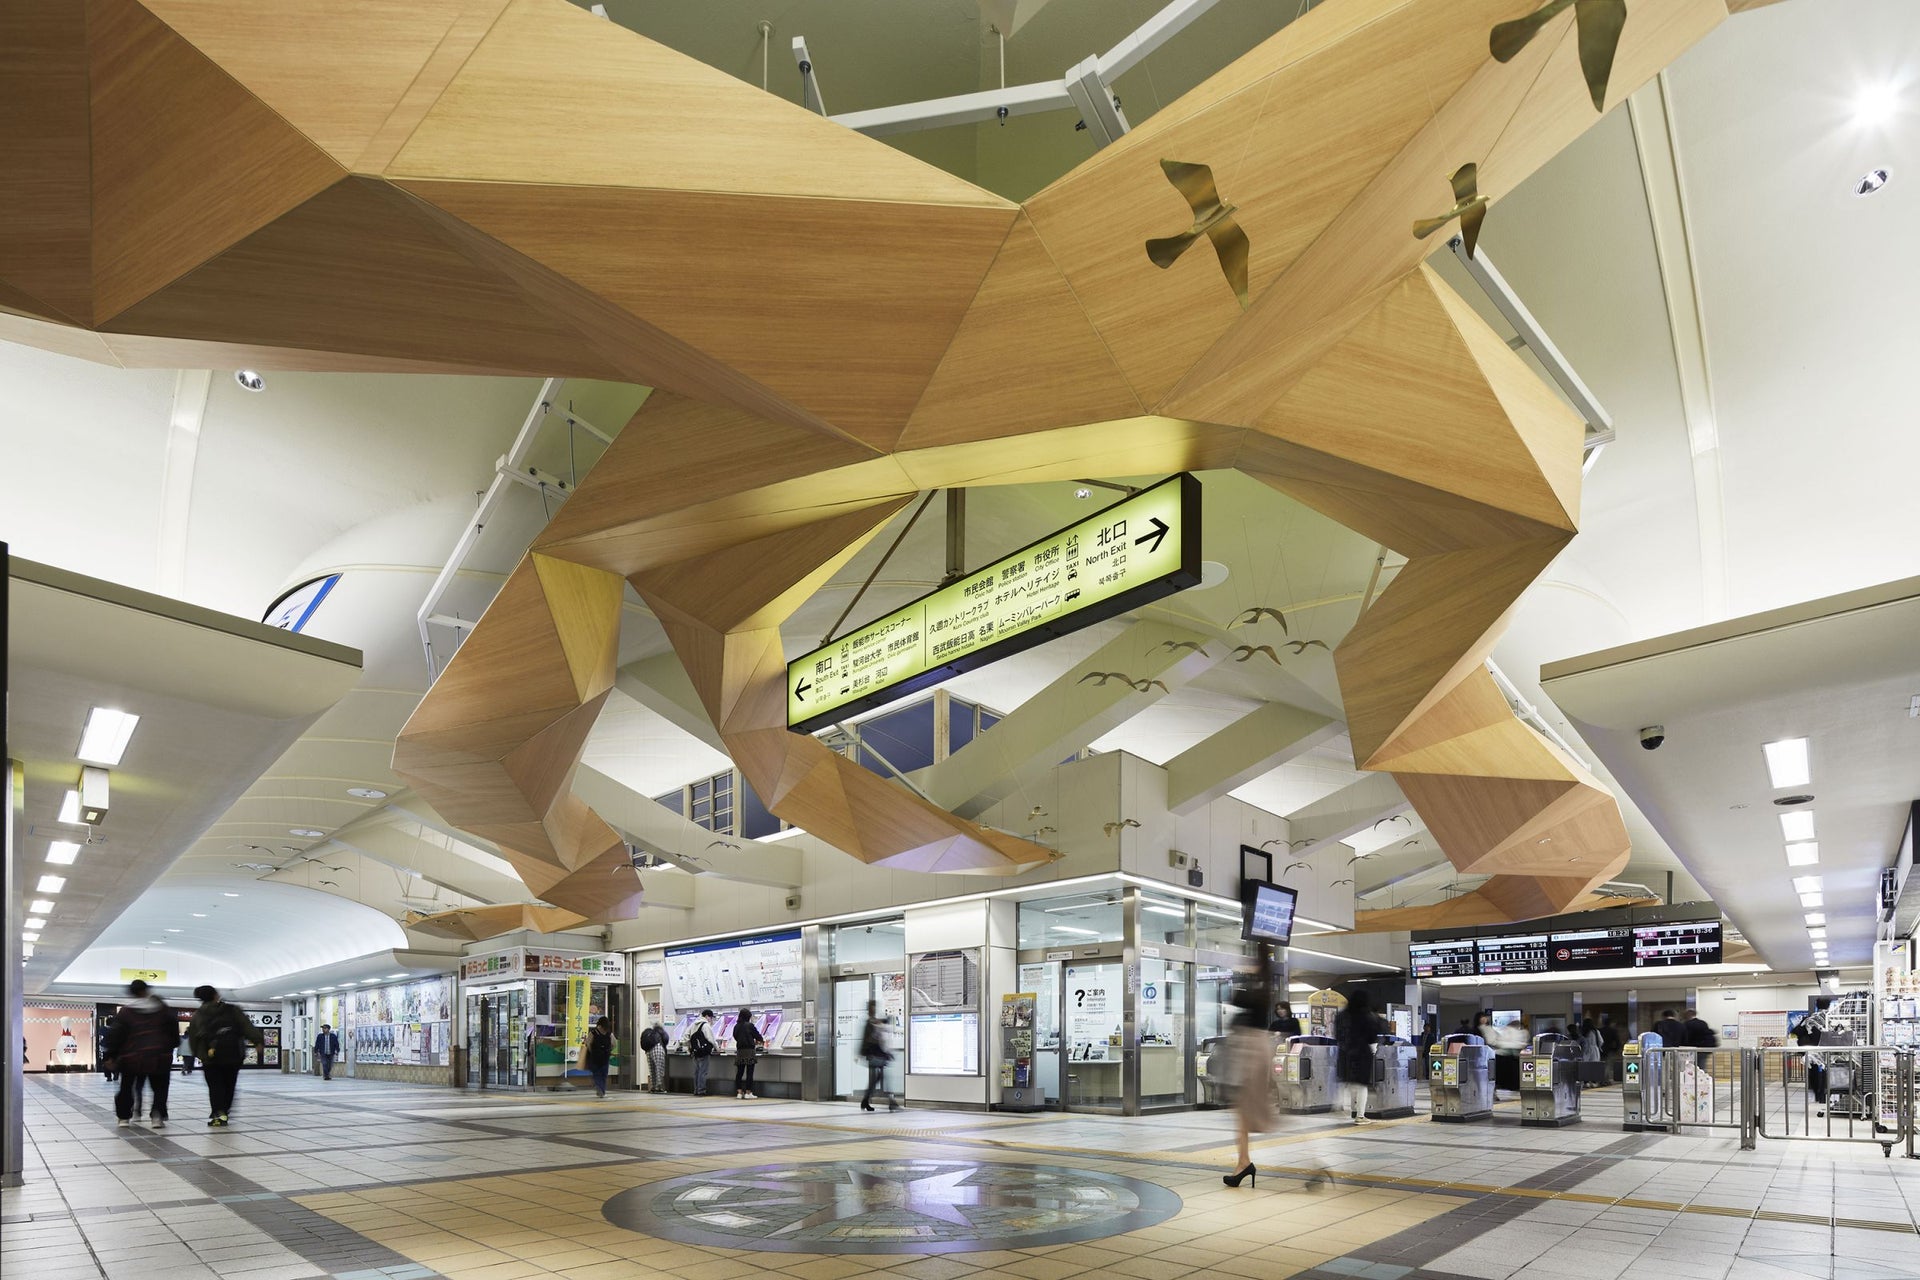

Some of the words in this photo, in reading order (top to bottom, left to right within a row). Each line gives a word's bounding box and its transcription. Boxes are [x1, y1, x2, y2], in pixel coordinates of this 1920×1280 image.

[1096, 519, 1127, 547] 北口
[1085, 550, 1109, 566] North
[1110, 542, 1127, 556] Exit
[1111, 554, 1127, 568] 北口
[963, 576, 994, 598] 市民会館
[1001, 560, 1026, 581] 警察署
[1033, 544, 1060, 565] 市役所
[997, 577, 1012, 588] Police
[1012, 571, 1028, 582] station
[1034, 562, 1044, 572] City
[1045, 557, 1060, 567] Office
[1065, 560, 1080, 571] TAXI
[994, 567, 1060, 605] ホテルヘリテイジ
[962, 615, 980, 626] Country
[1026, 589, 1039, 599] Hotel
[1039, 580, 1060, 593] Heritage
[932, 629, 976, 656] 西武飯能日高
[998, 594, 1061, 628] ムーミンバレーパーク
[998, 625, 1016, 635] Moomin
[1016, 618, 1031, 628] Valley
[1031, 613, 1042, 623] Park
[887, 631, 920, 652] 市民体育館
[815, 656, 832, 676] 南口
[815, 674, 829, 685] South
[829, 669, 839, 679] Exit
[542, 954, 602, 971] ぷらっと飯能
[1087, 988, 1106, 997] ご案内
[1523, 1062, 1534, 1071] IC
